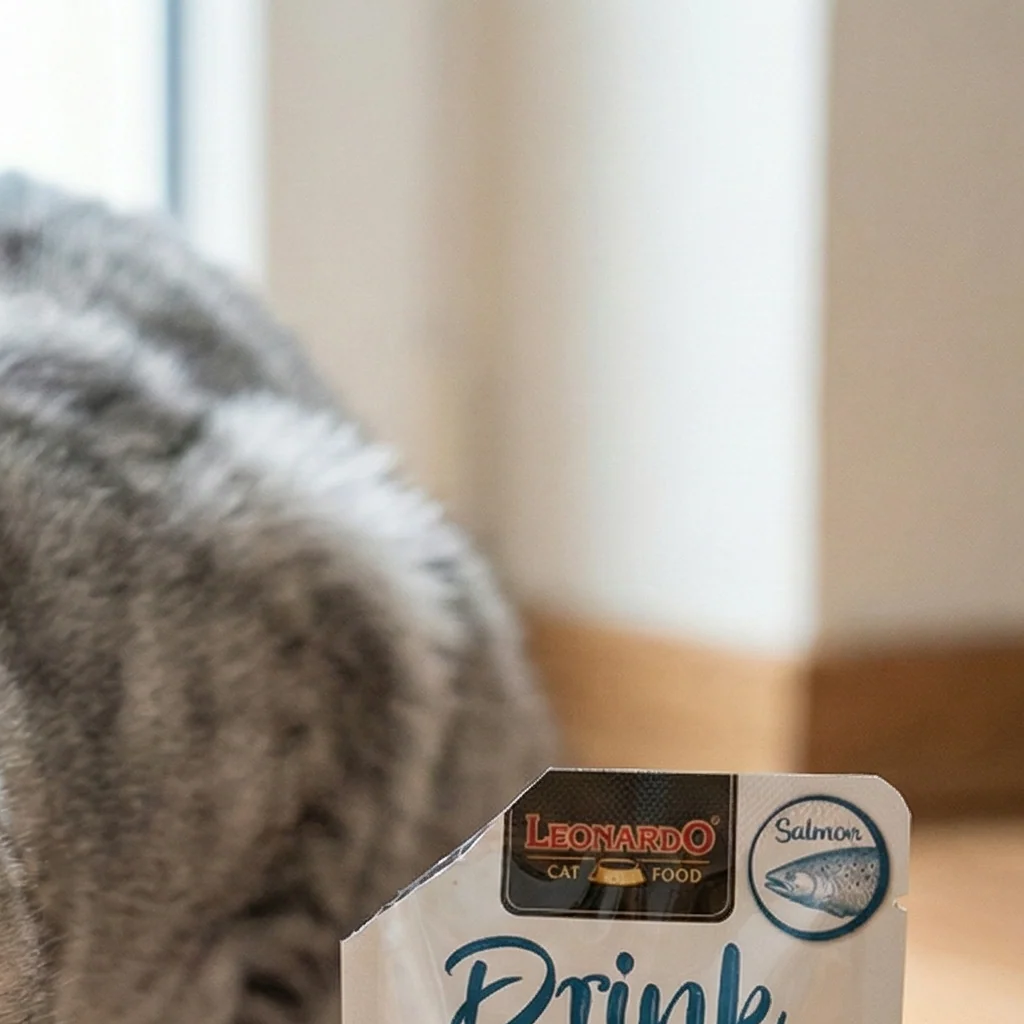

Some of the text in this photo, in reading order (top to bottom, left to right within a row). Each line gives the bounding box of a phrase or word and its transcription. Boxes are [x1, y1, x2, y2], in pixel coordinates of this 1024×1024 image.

[525, 814, 716, 856] LEONARDO
[547, 865, 702, 884] CAT FOOD
